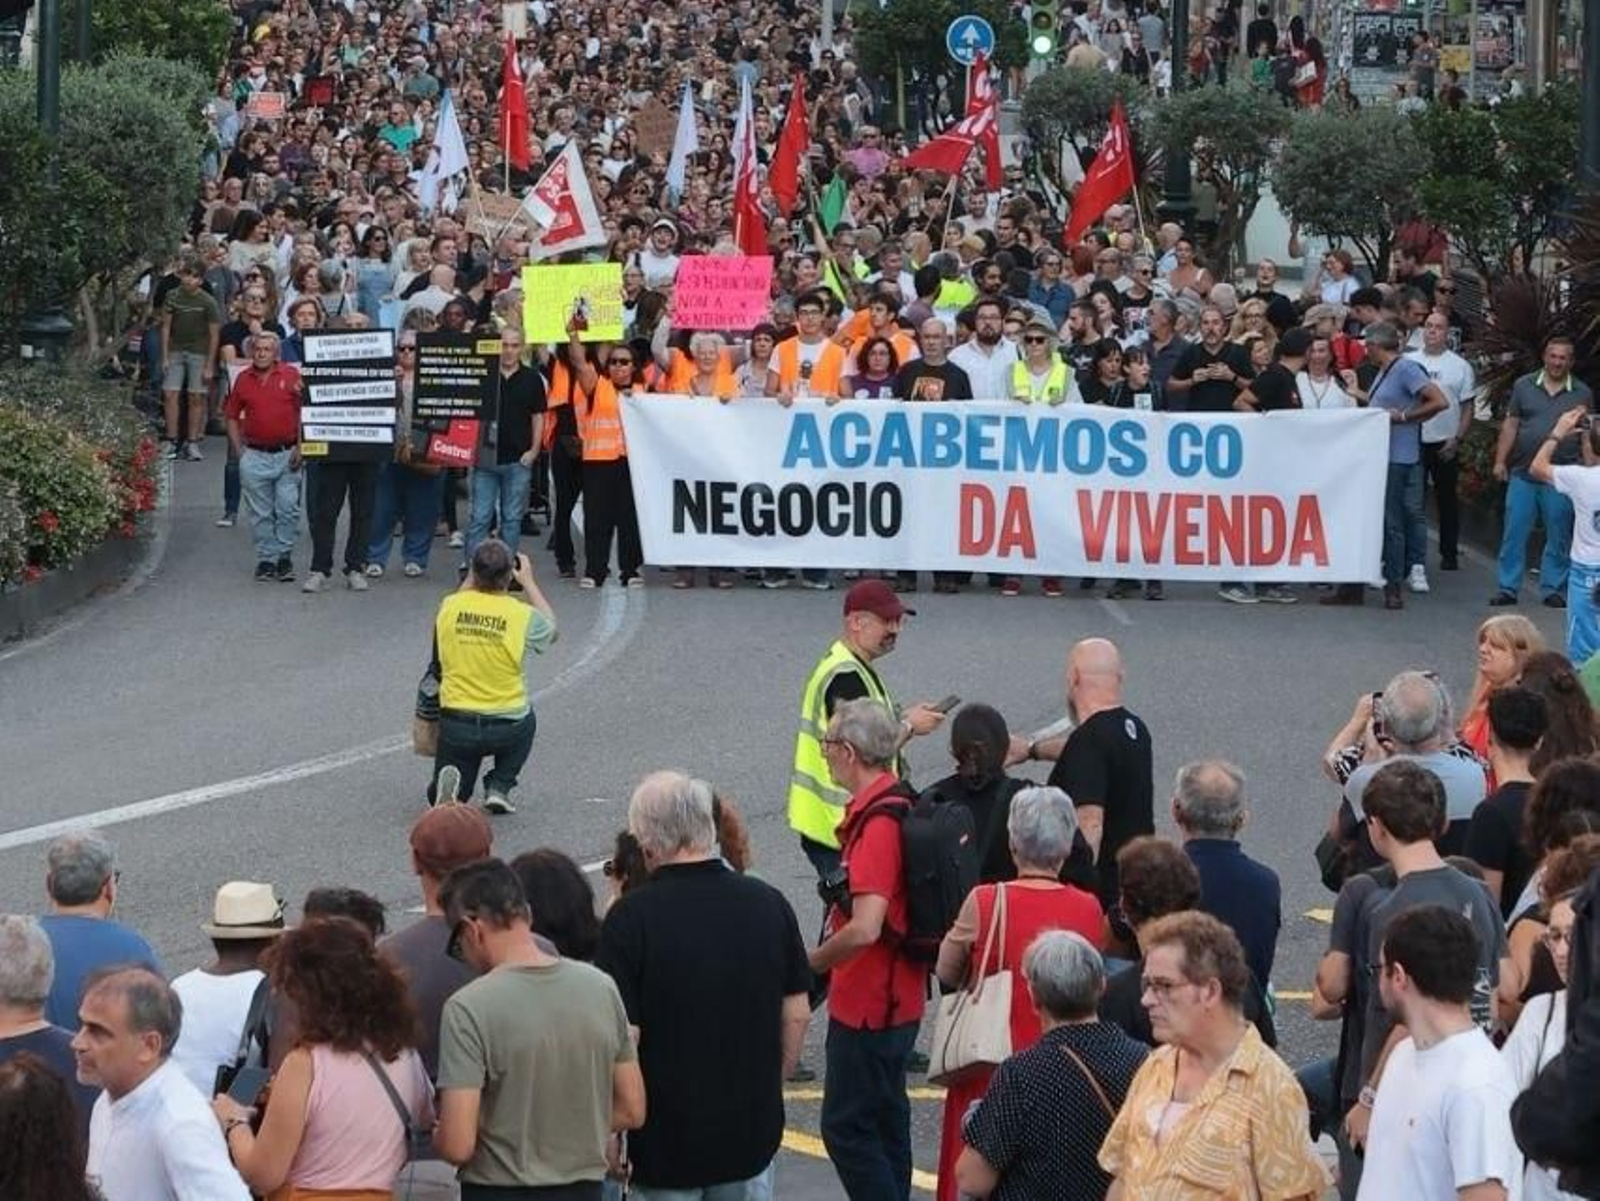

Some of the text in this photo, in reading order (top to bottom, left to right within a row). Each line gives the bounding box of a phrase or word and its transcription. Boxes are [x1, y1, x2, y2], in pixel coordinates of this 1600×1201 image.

[783, 412, 1242, 478] ACABEMOS CO
[672, 480, 1331, 567] NEGOCIO DA VIVENDA
